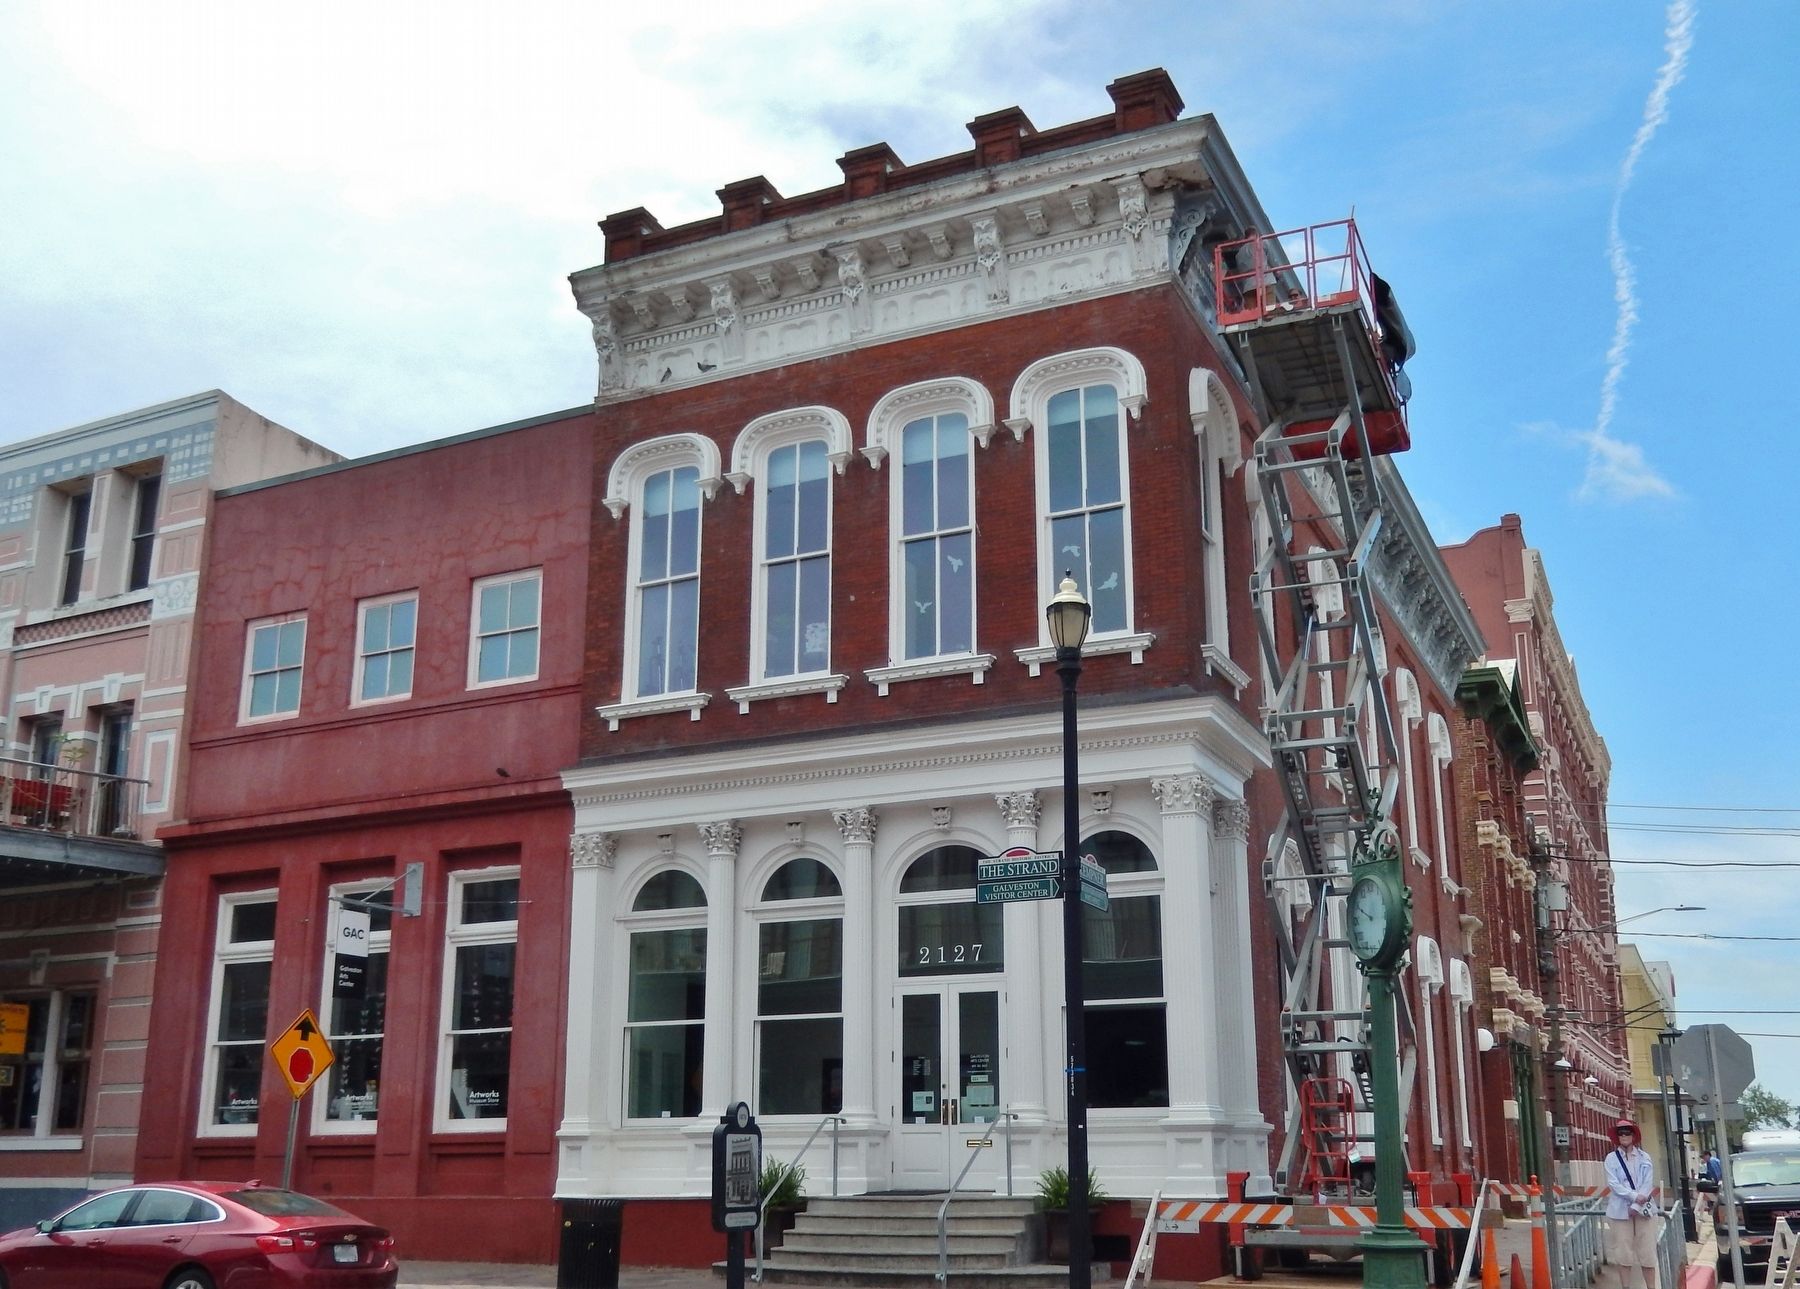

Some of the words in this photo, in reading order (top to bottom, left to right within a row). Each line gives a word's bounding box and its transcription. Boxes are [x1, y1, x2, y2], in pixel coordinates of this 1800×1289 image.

[980, 864, 1005, 878] THE
[1007, 860, 1058, 876] STRAND
[992, 881, 1040, 892] GALVESTON
[985, 890, 1016, 901] VISITOR
[1016, 889, 1049, 899] CENTER
[343, 926, 365, 940] GAC
[919, 944, 983, 964] 2127
[338, 979, 356, 987] Center
[470, 1089, 500, 1098] Artworks
